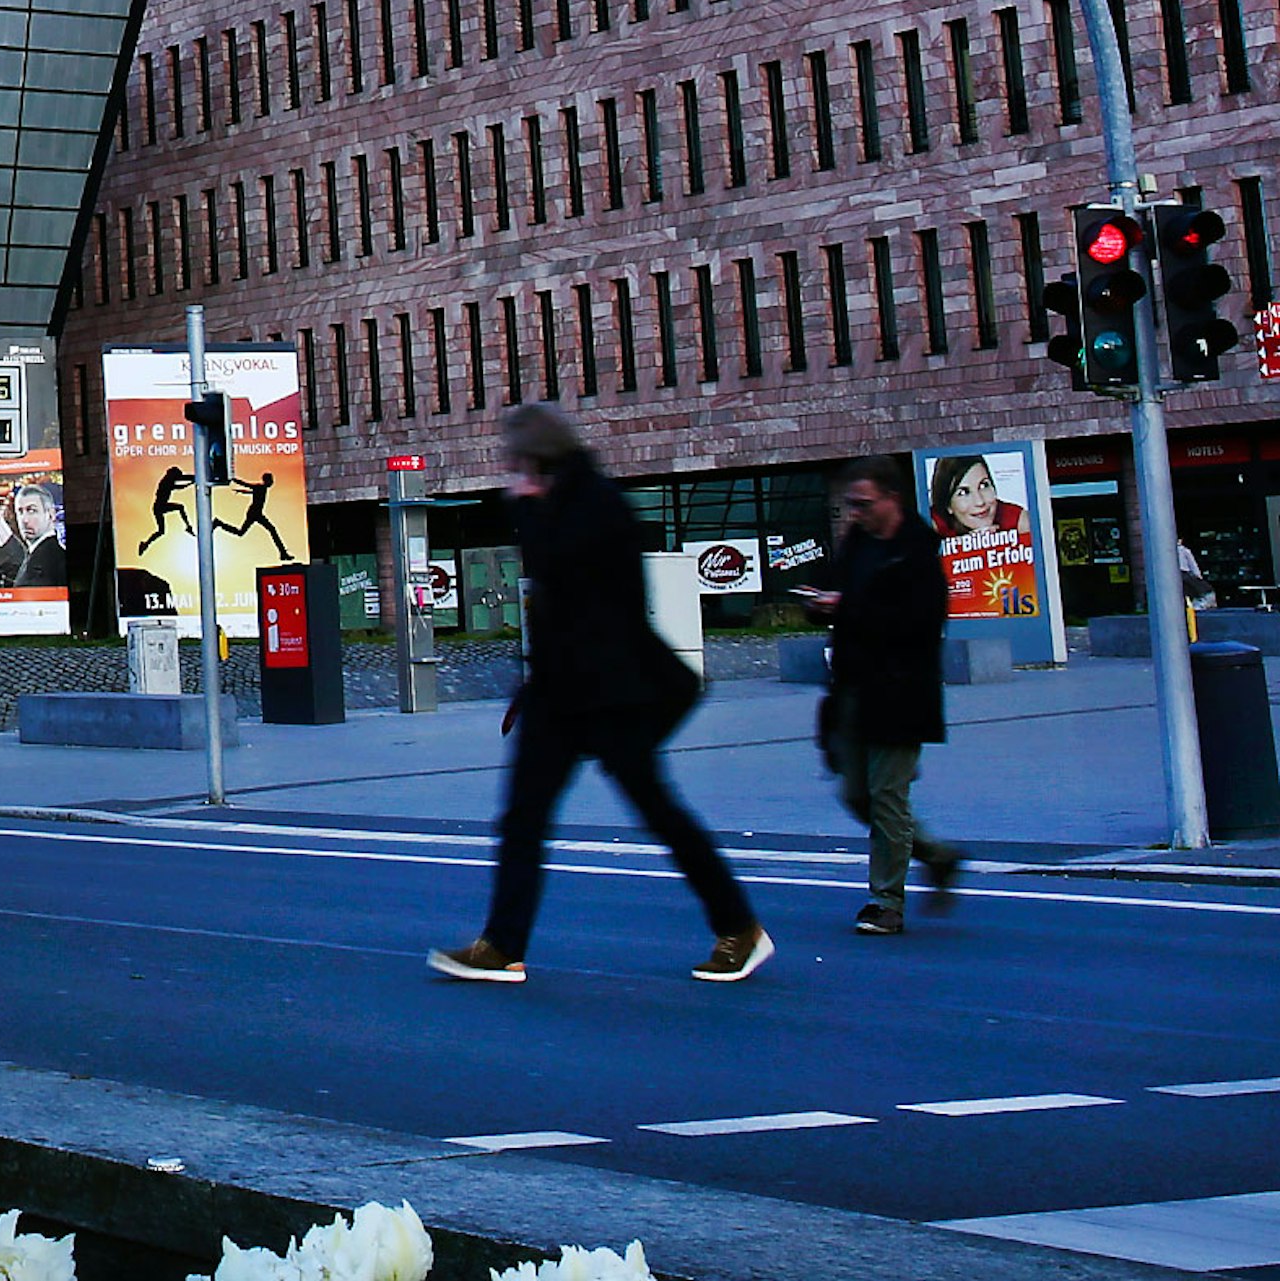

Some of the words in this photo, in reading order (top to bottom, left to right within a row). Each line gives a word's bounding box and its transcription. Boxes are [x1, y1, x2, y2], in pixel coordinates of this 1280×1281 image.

[114, 415, 298, 445] grennlos
[115, 444, 143, 457] OPER
[147, 444, 177, 456] CHOR
[277, 442, 298, 455] POP
[1187, 445, 1224, 457] HOTELS
[1055, 455, 1104, 468] SOUVENIRS
[962, 528, 1018, 553] Bildung
[952, 555, 983, 575] zum
[987, 546, 1034, 568] Erfolg
[144, 593, 164, 610] 13.
[166, 593, 193, 609] MAI
[1000, 585, 1035, 615] ils
